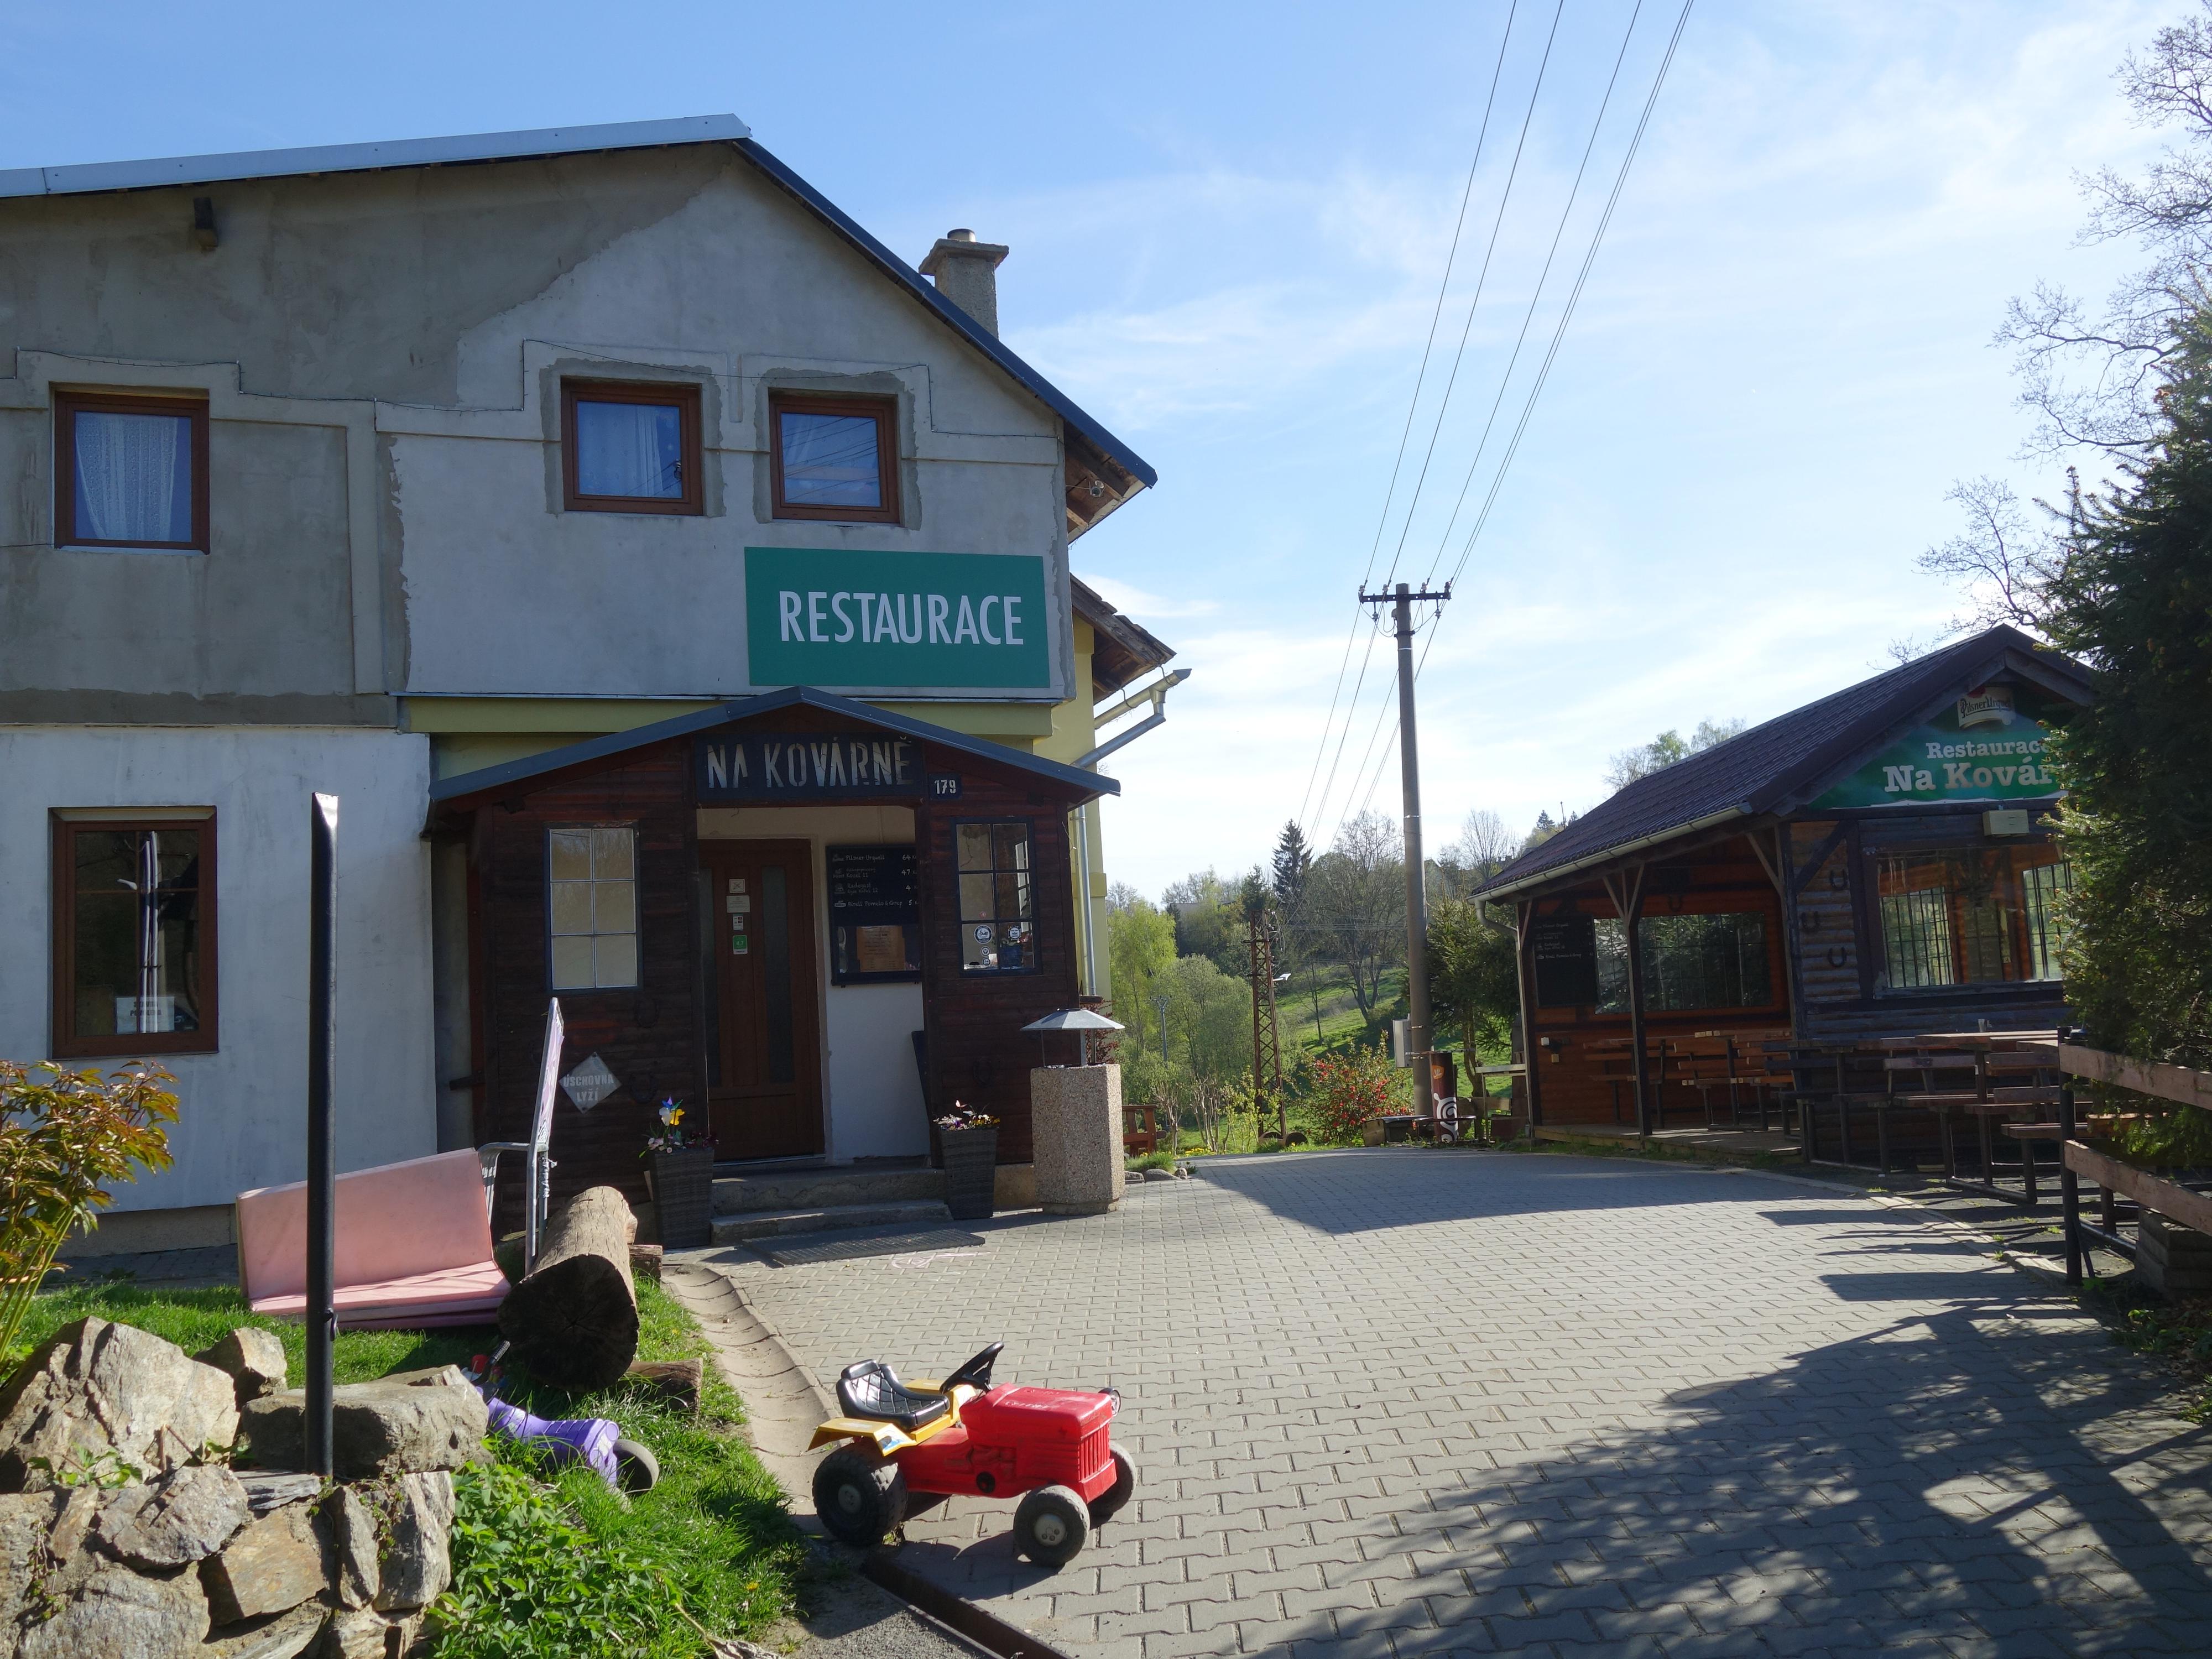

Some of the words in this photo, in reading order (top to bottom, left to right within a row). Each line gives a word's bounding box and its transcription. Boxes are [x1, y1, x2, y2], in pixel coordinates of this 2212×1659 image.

[779, 591, 1024, 645] RESTAURACE
[1960, 698, 1986, 718] Pilsner
[707, 742, 748, 789] NA
[764, 735, 913, 788] KOVÁRNĚ
[1882, 765, 1936, 792] Na
[1942, 756, 2054, 790] Kovár
[934, 779, 956, 794] 179
[563, 1074, 614, 1087] ÚSCHOVNA
[576, 1088, 598, 1102] LYŽÍ
